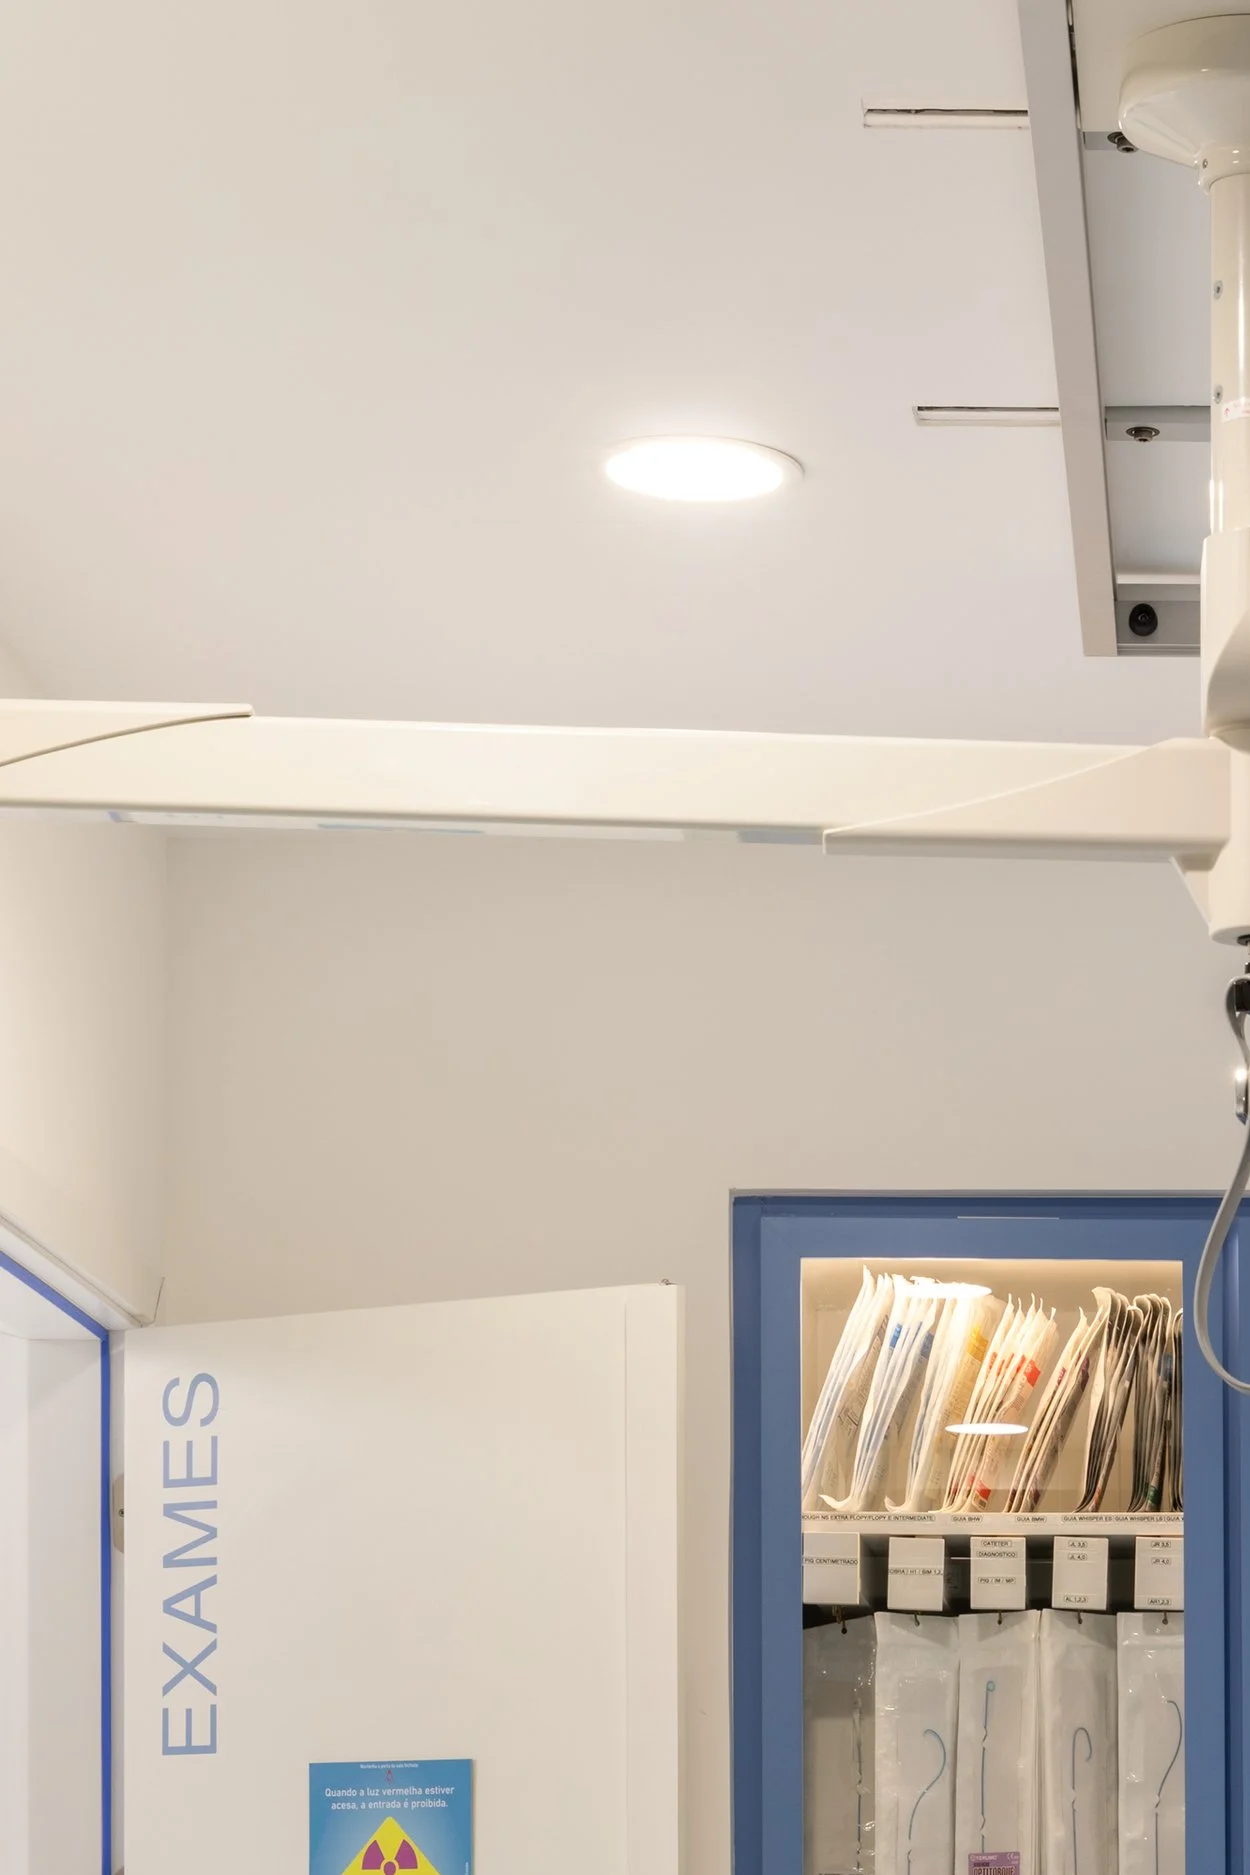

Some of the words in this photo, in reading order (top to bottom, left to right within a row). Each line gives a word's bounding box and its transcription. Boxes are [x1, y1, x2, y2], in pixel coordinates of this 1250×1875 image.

[161, 1370, 220, 1757] EXAMES
[325, 1787, 357, 1797] Quando
[359, 1789, 365, 1797] a
[367, 1787, 379, 1796] luz
[382, 1786, 423, 1796] vermelha
[425, 1785, 455, 1795] estiver
[331, 1803, 358, 1811] acesa,
[361, 1802, 366, 1810] a
[368, 1800, 401, 1810] entrada
[403, 1799, 409, 1809] é
[411, 1799, 449, 1811] proibida.
